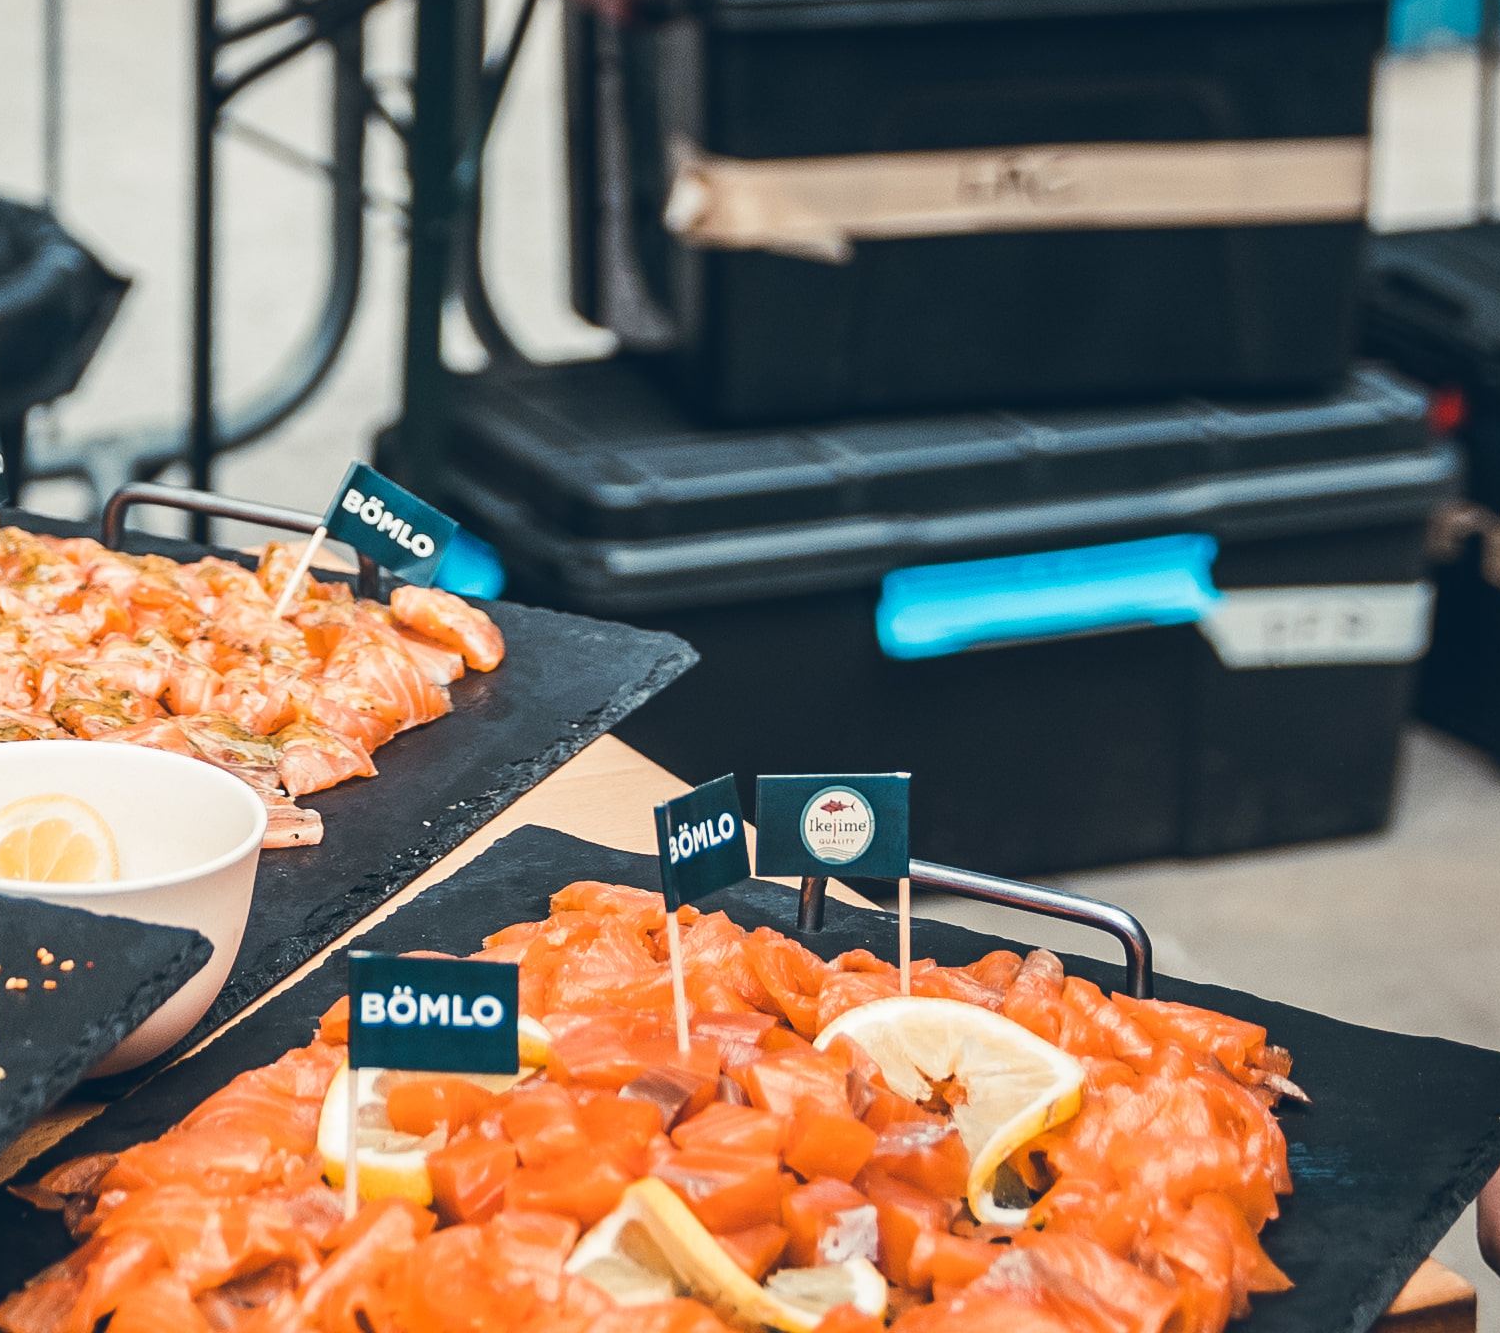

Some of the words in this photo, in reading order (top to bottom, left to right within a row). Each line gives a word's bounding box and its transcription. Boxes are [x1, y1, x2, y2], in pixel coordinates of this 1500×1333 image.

[341, 488, 436, 559] BÖMLO
[669, 812, 736, 865] BÖMLO
[809, 819, 868, 838] Ikejime
[819, 838, 856, 846] QUALITY
[359, 985, 504, 1028] BÖMLO
